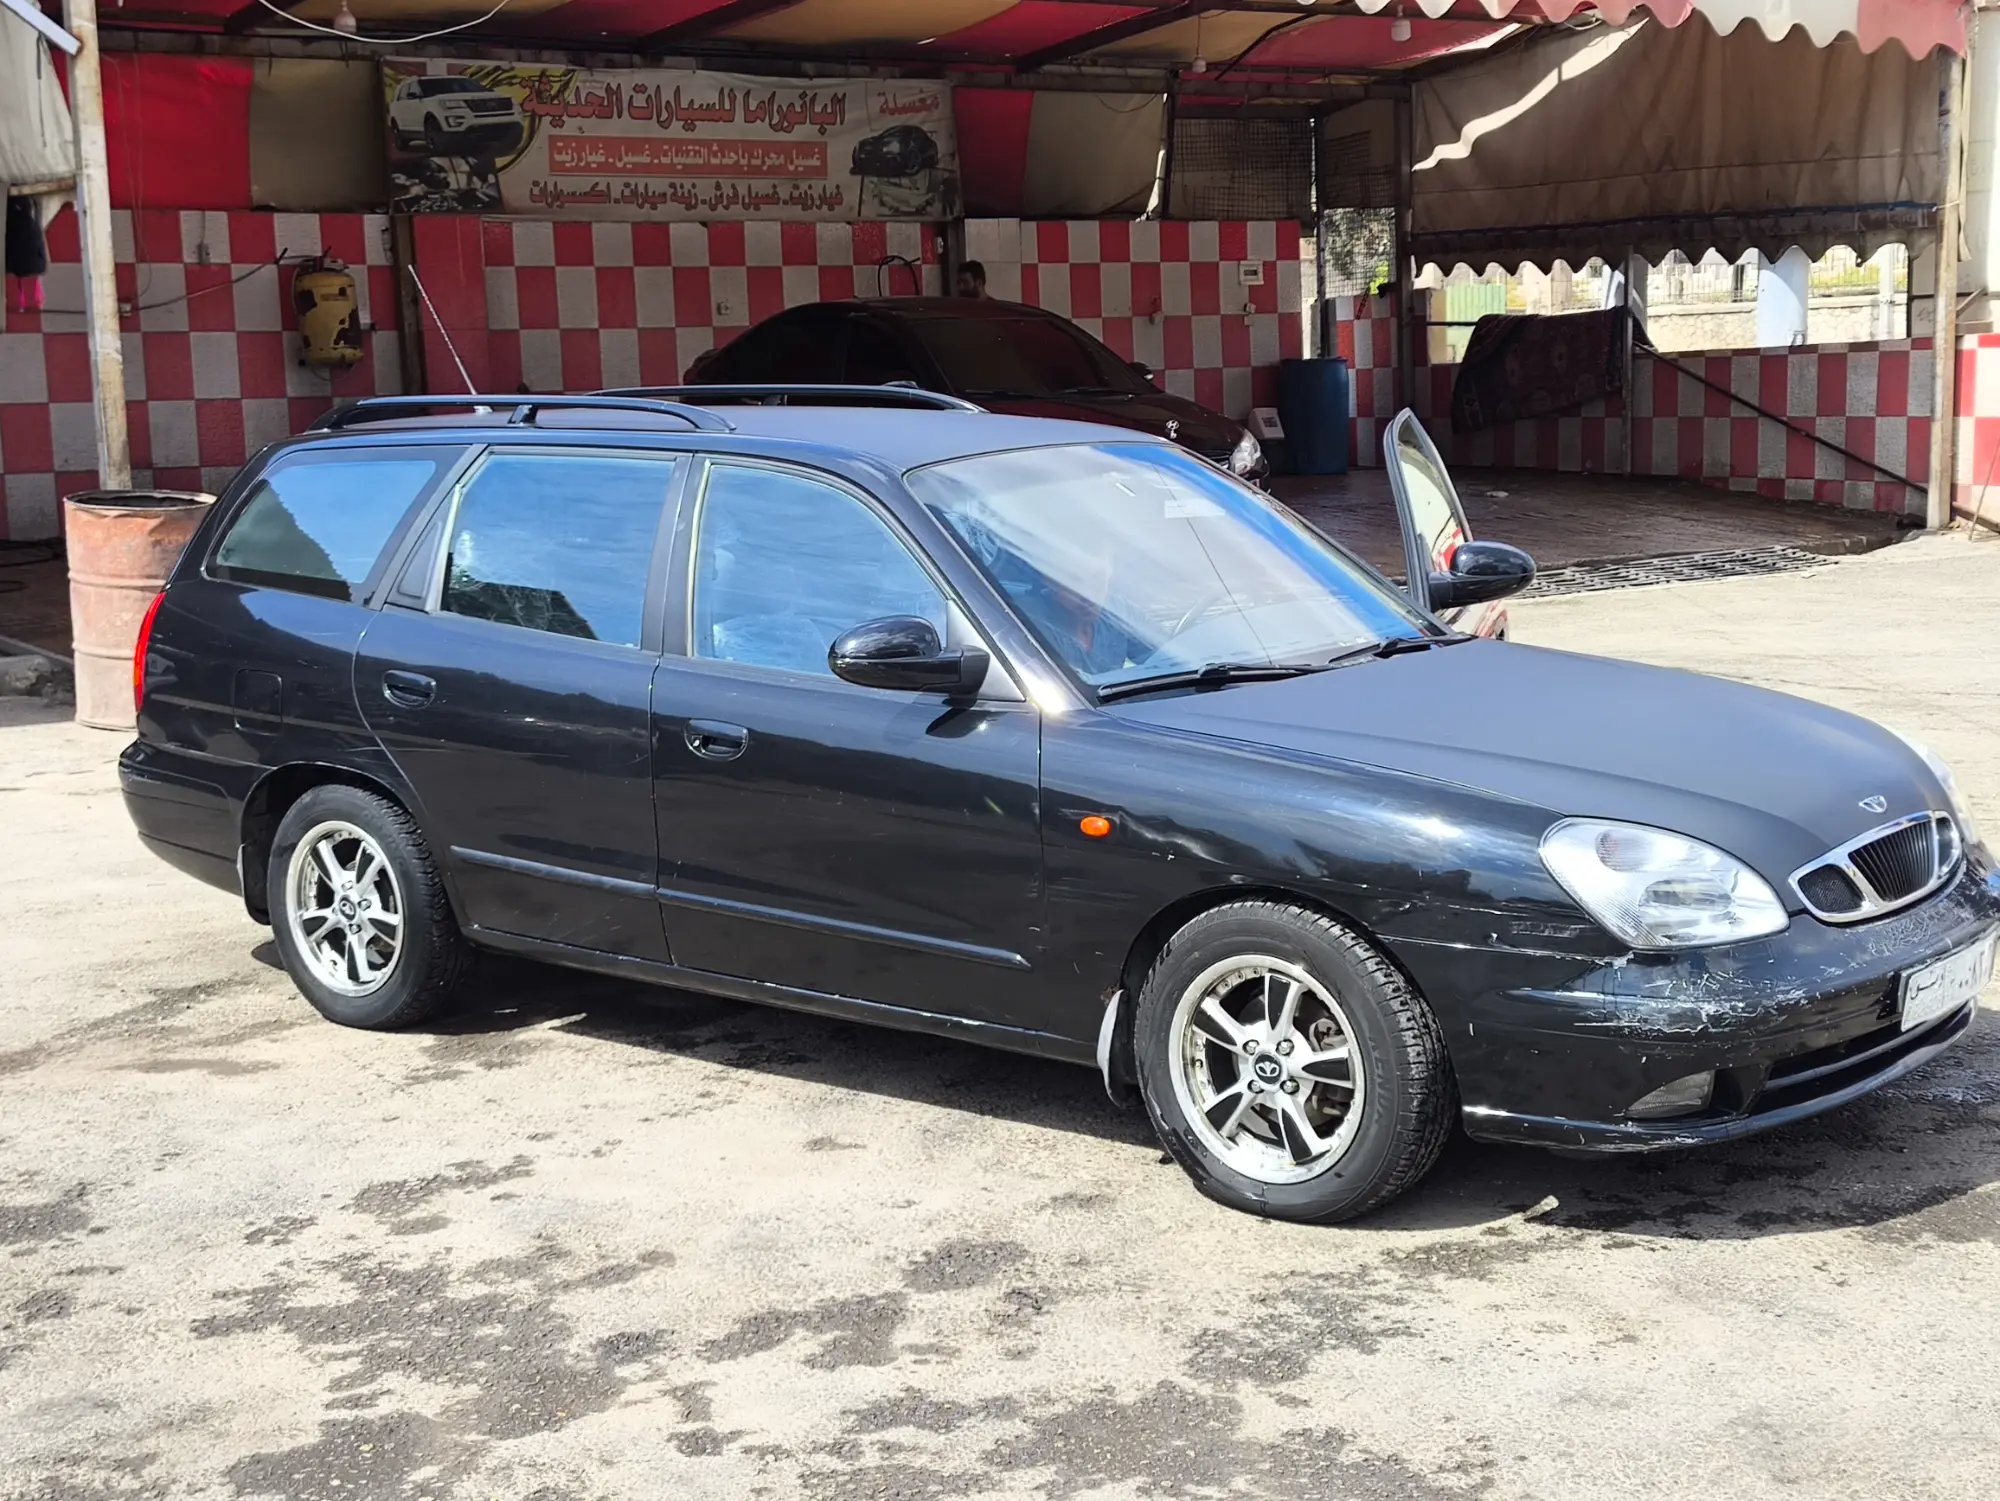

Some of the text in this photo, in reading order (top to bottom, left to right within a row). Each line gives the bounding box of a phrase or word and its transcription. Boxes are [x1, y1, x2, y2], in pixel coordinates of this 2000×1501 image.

[521, 74, 847, 136] البانوراما للسيارات الحديثة
[553, 141, 578, 167] زيت
[579, 144, 606, 168] غيار
[615, 144, 651, 168] غسيل
[660, 145, 708, 169] التقنيات
[750, 147, 785, 170] محرك
[787, 146, 821, 170] غسيل
[621, 180, 667, 211] سيارات
[741, 182, 781, 211] غسيل
[789, 181, 815, 211] زيت
[815, 183, 844, 211] غيار
